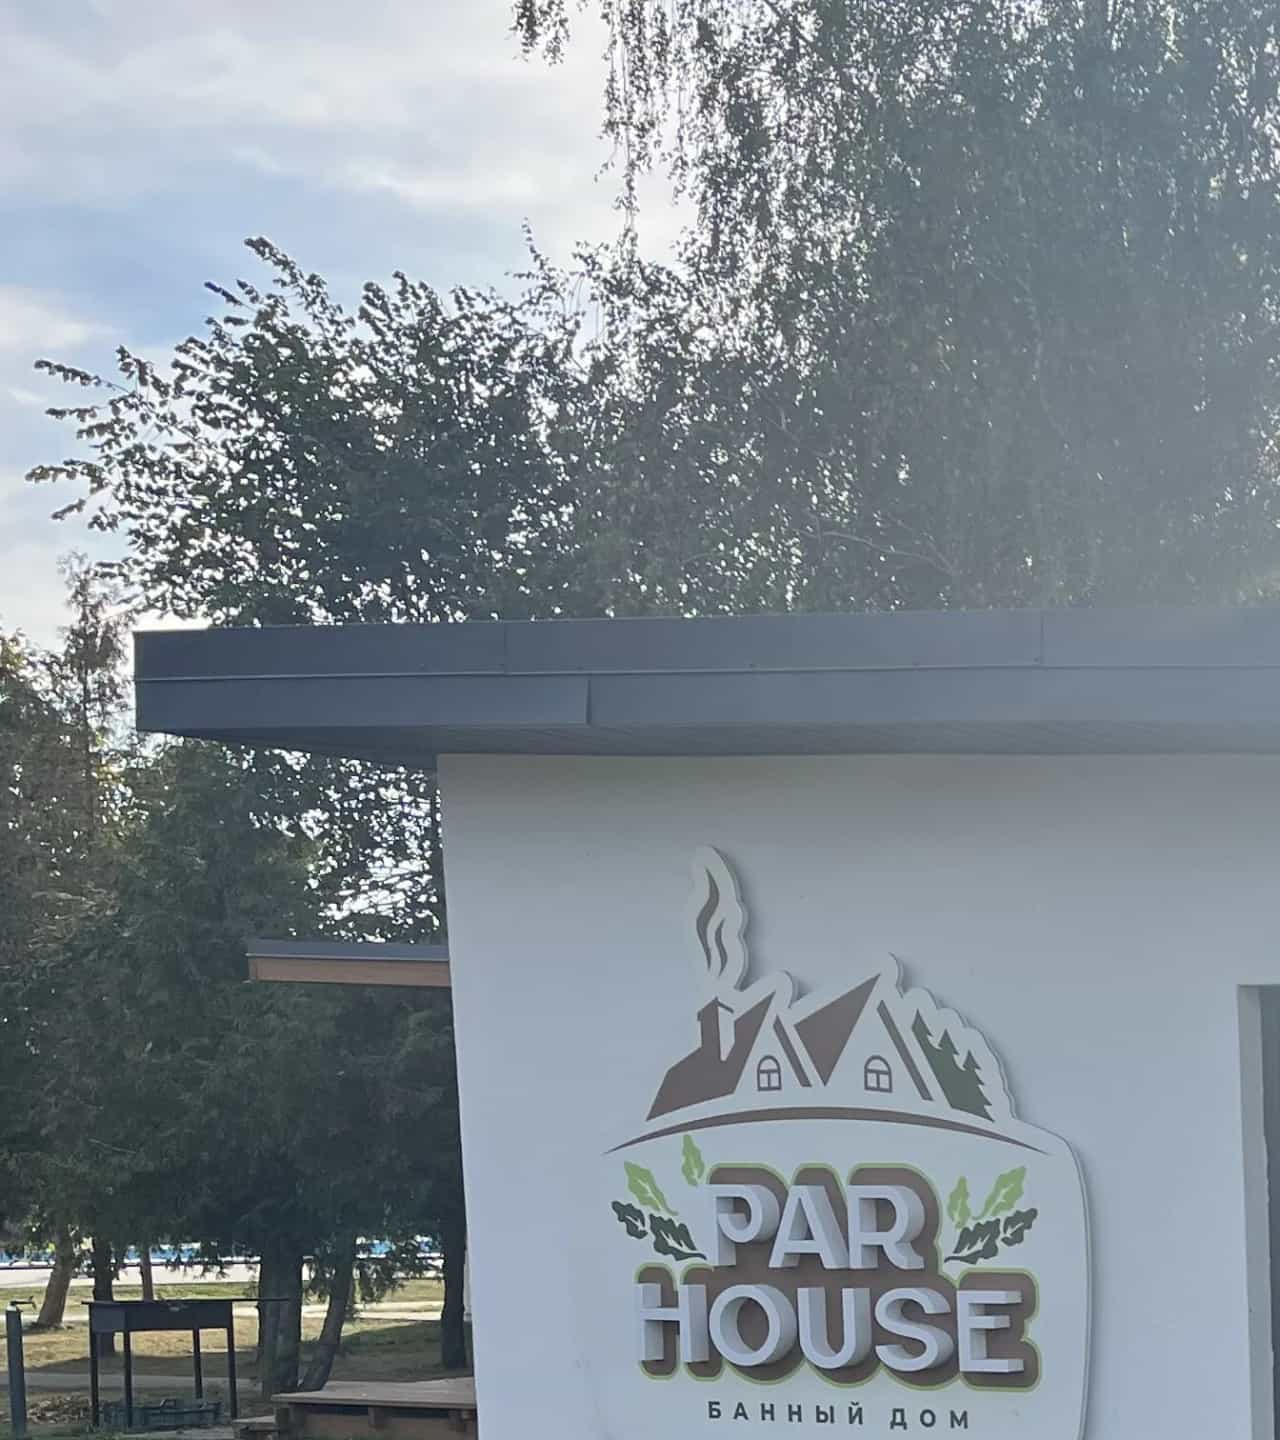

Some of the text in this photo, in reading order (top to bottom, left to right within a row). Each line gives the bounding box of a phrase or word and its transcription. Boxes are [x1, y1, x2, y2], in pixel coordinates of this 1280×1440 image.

[703, 1183, 926, 1270] PAR
[634, 1282, 1024, 1373] HOUSE
[708, 1401, 969, 1430] БАННЫЙ ДОМ
